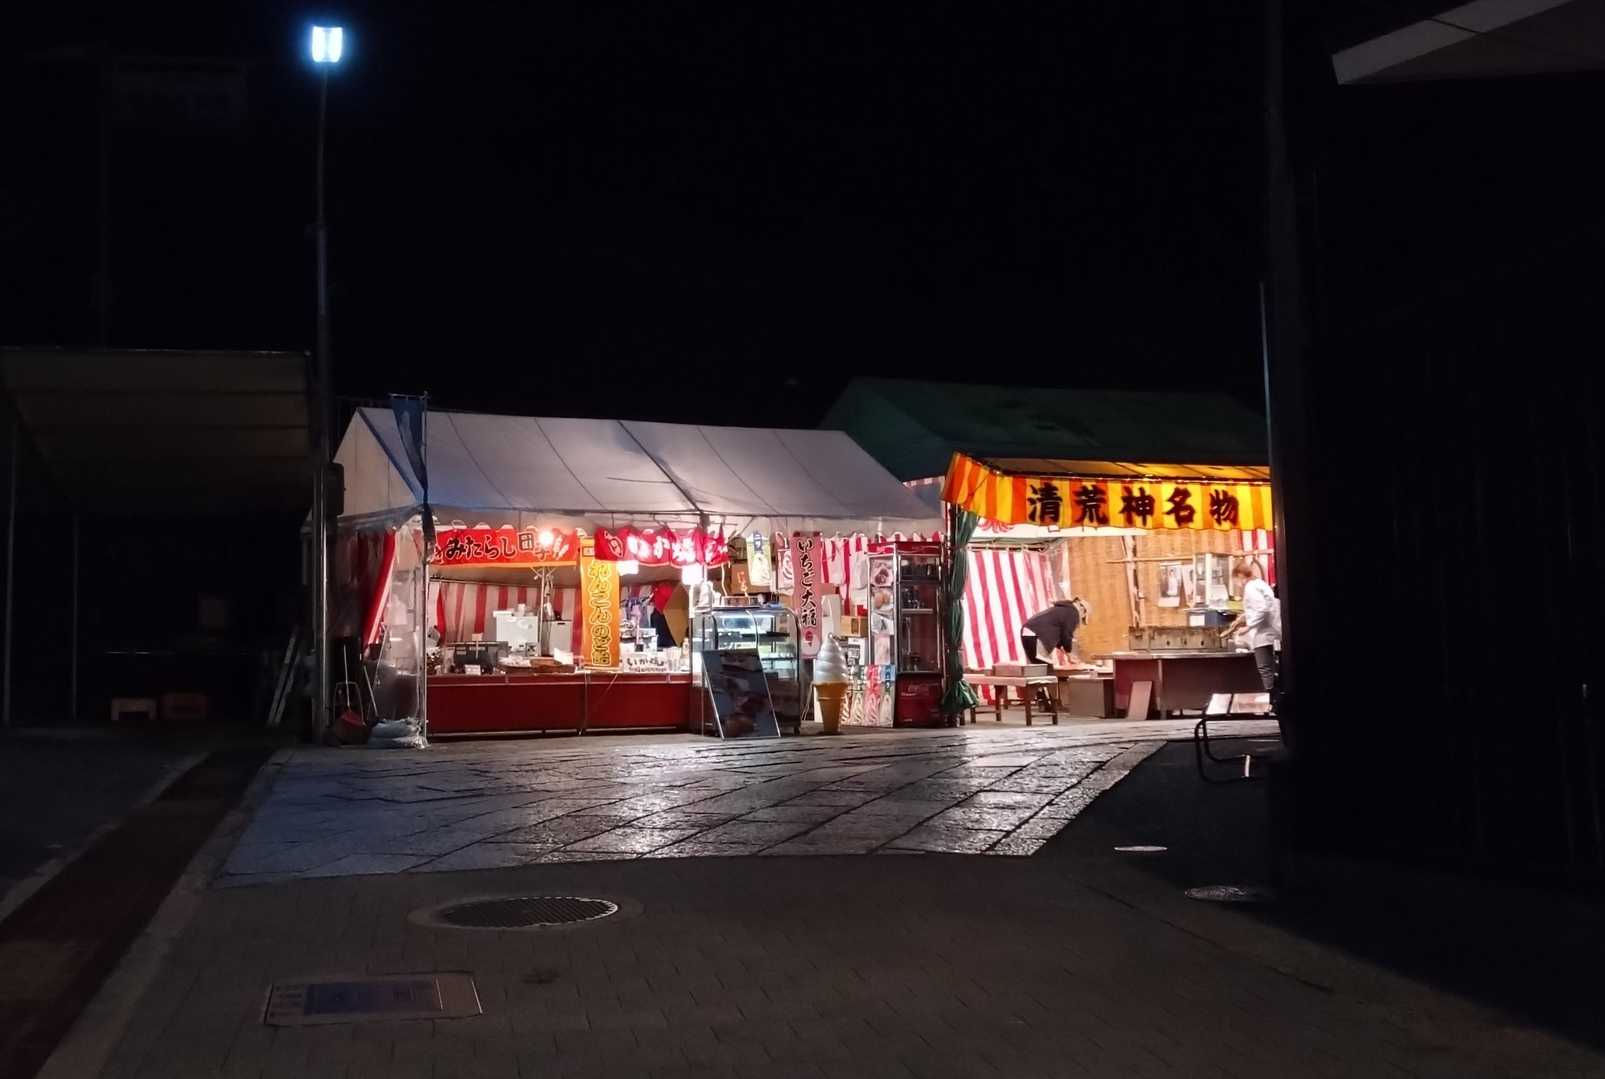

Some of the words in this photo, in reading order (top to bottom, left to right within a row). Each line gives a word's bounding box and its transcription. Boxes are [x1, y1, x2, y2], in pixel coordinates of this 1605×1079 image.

[1029, 484, 1240, 526] 清荒神名物
[797, 537, 818, 627] いちご大福
